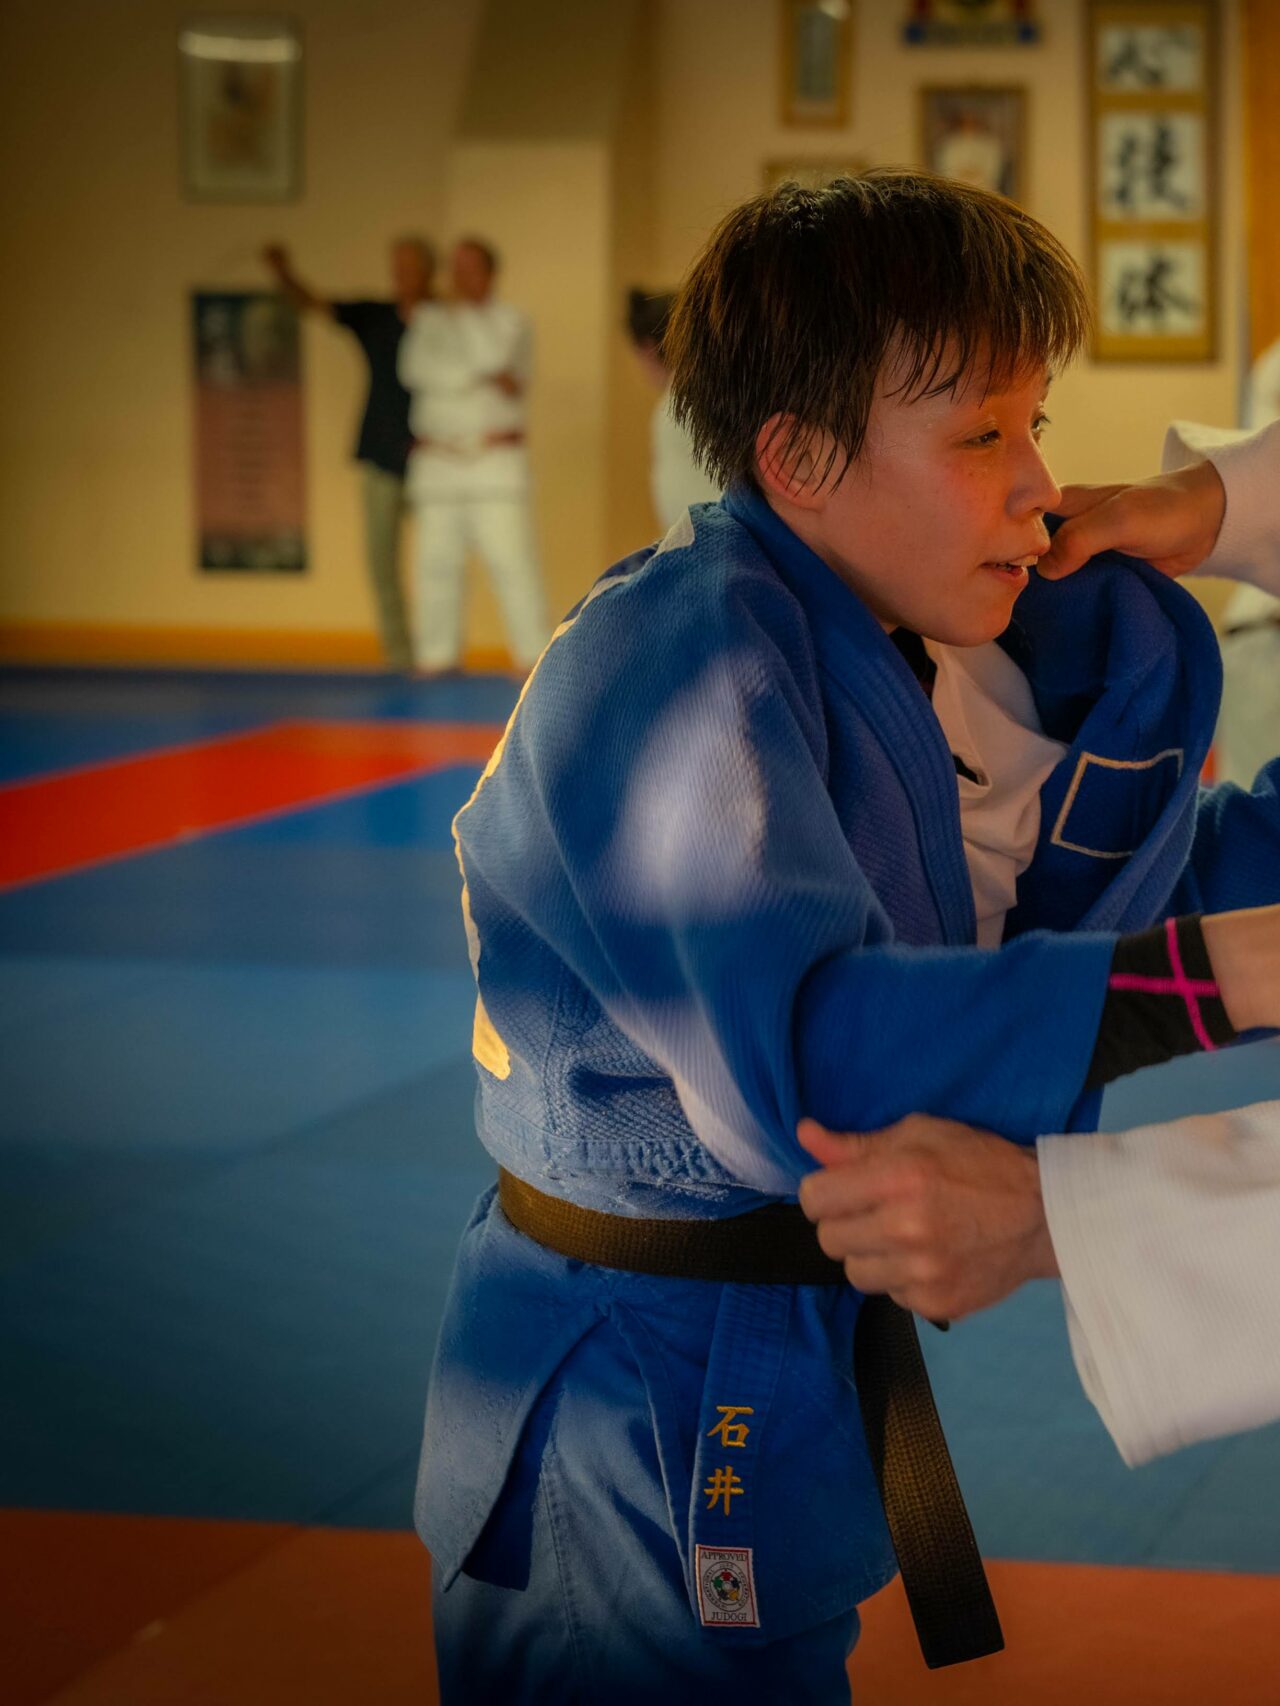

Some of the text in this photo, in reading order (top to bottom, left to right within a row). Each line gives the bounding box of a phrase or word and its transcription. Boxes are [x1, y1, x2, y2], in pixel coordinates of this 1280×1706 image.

[704, 1405, 754, 1516] 石井
[701, 1551, 748, 1562] APPROVED
[711, 1611, 748, 1621] JUDOGI
